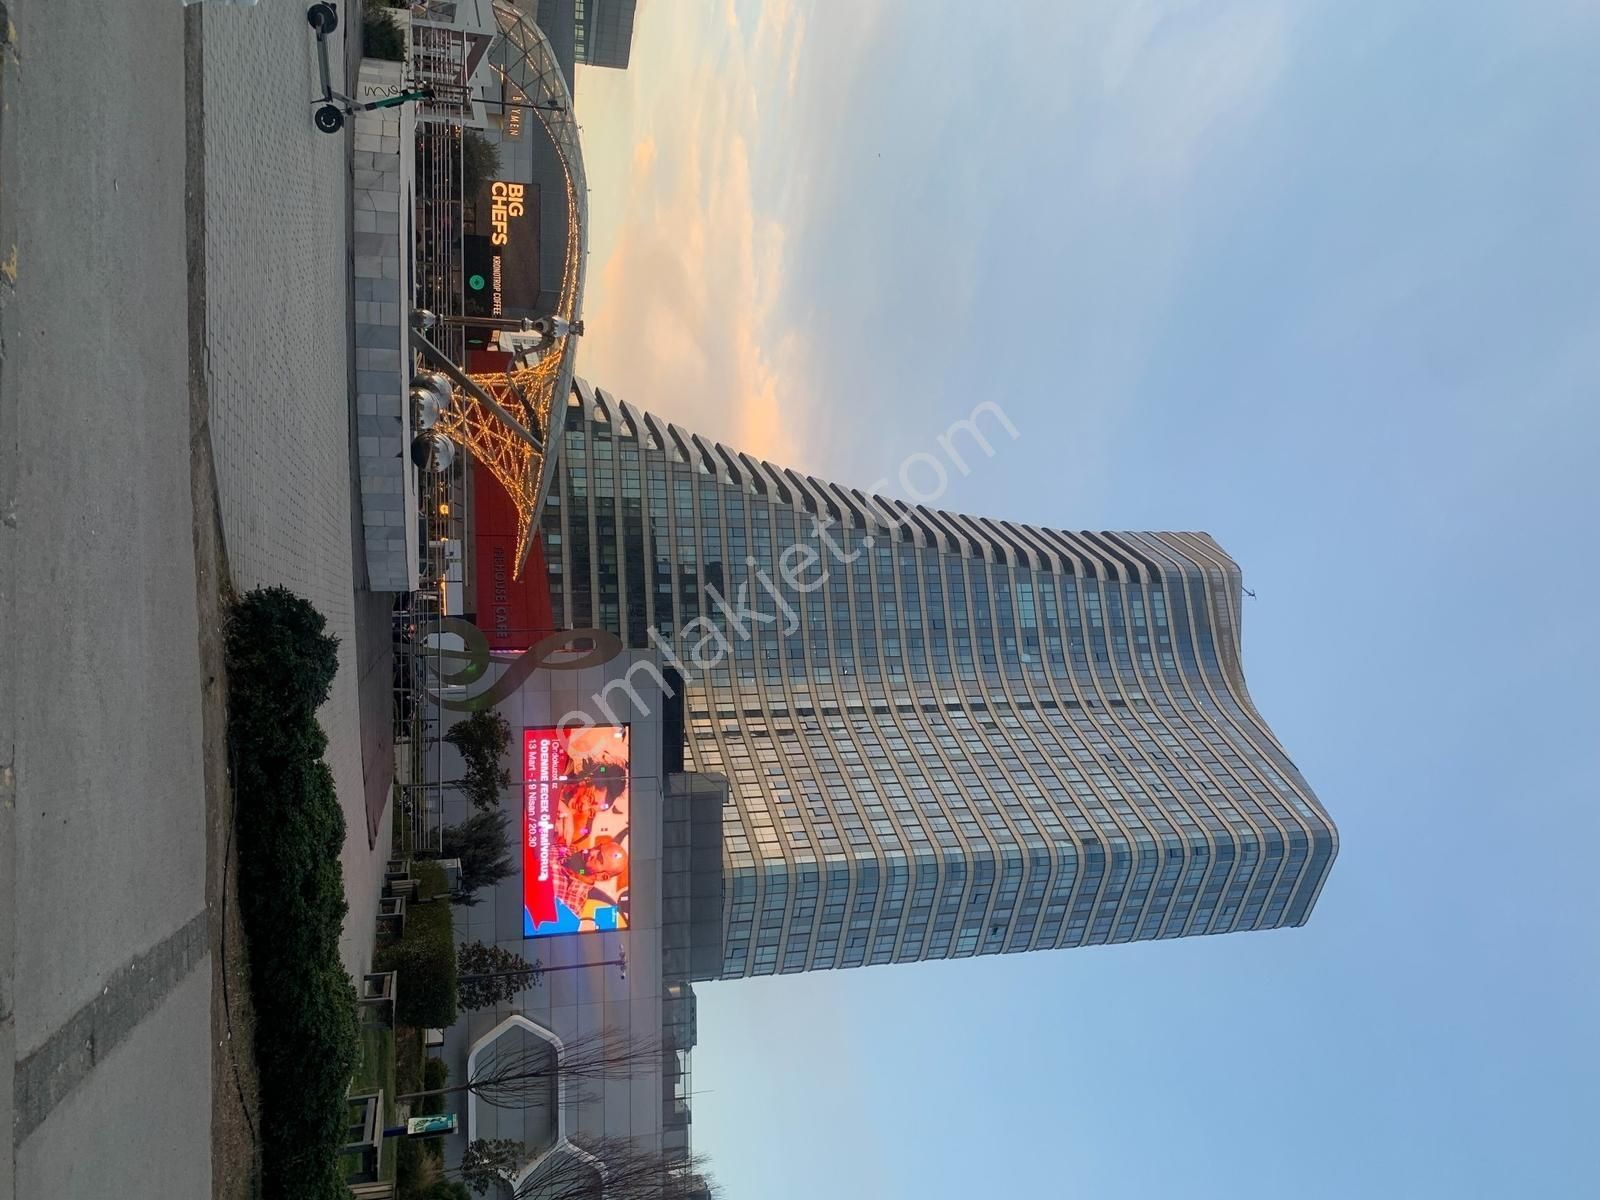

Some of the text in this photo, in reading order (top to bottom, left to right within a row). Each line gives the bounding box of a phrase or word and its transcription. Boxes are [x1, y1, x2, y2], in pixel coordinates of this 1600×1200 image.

[509, 96, 522, 136] BYMEN
[491, 182, 507, 245] CHEFS
[508, 184, 524, 217] BIG
[492, 256, 502, 315] KRONOTROP COFFEE
[495, 564, 506, 601] HOUSE
[529, 739, 536, 749] 13
[529, 792, 537, 816] Nisan
[529, 824, 537, 847] 20.30
